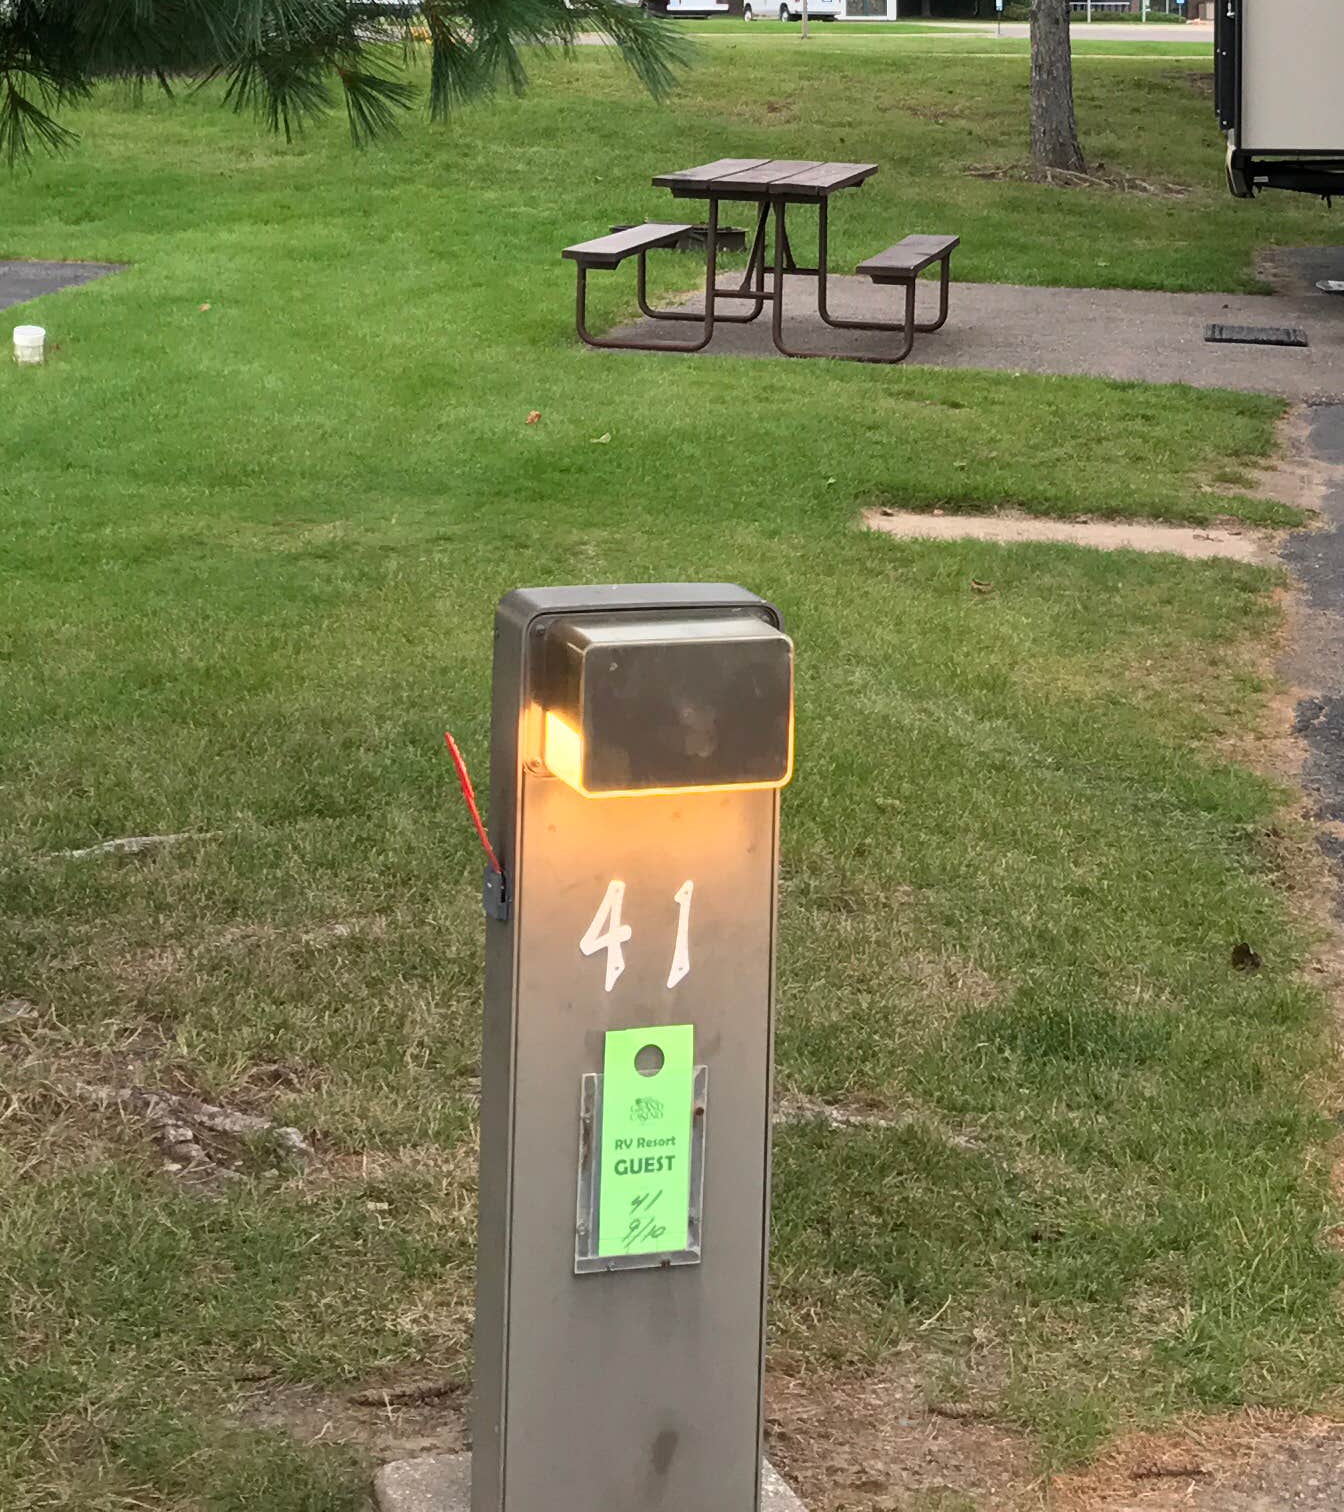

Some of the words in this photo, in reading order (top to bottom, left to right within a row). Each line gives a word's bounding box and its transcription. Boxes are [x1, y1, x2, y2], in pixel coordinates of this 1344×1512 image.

[579, 879, 694, 992] 41
[614, 1138, 633, 1150] RV
[636, 1136, 676, 1149] Resort
[614, 1155, 676, 1176] GUEST
